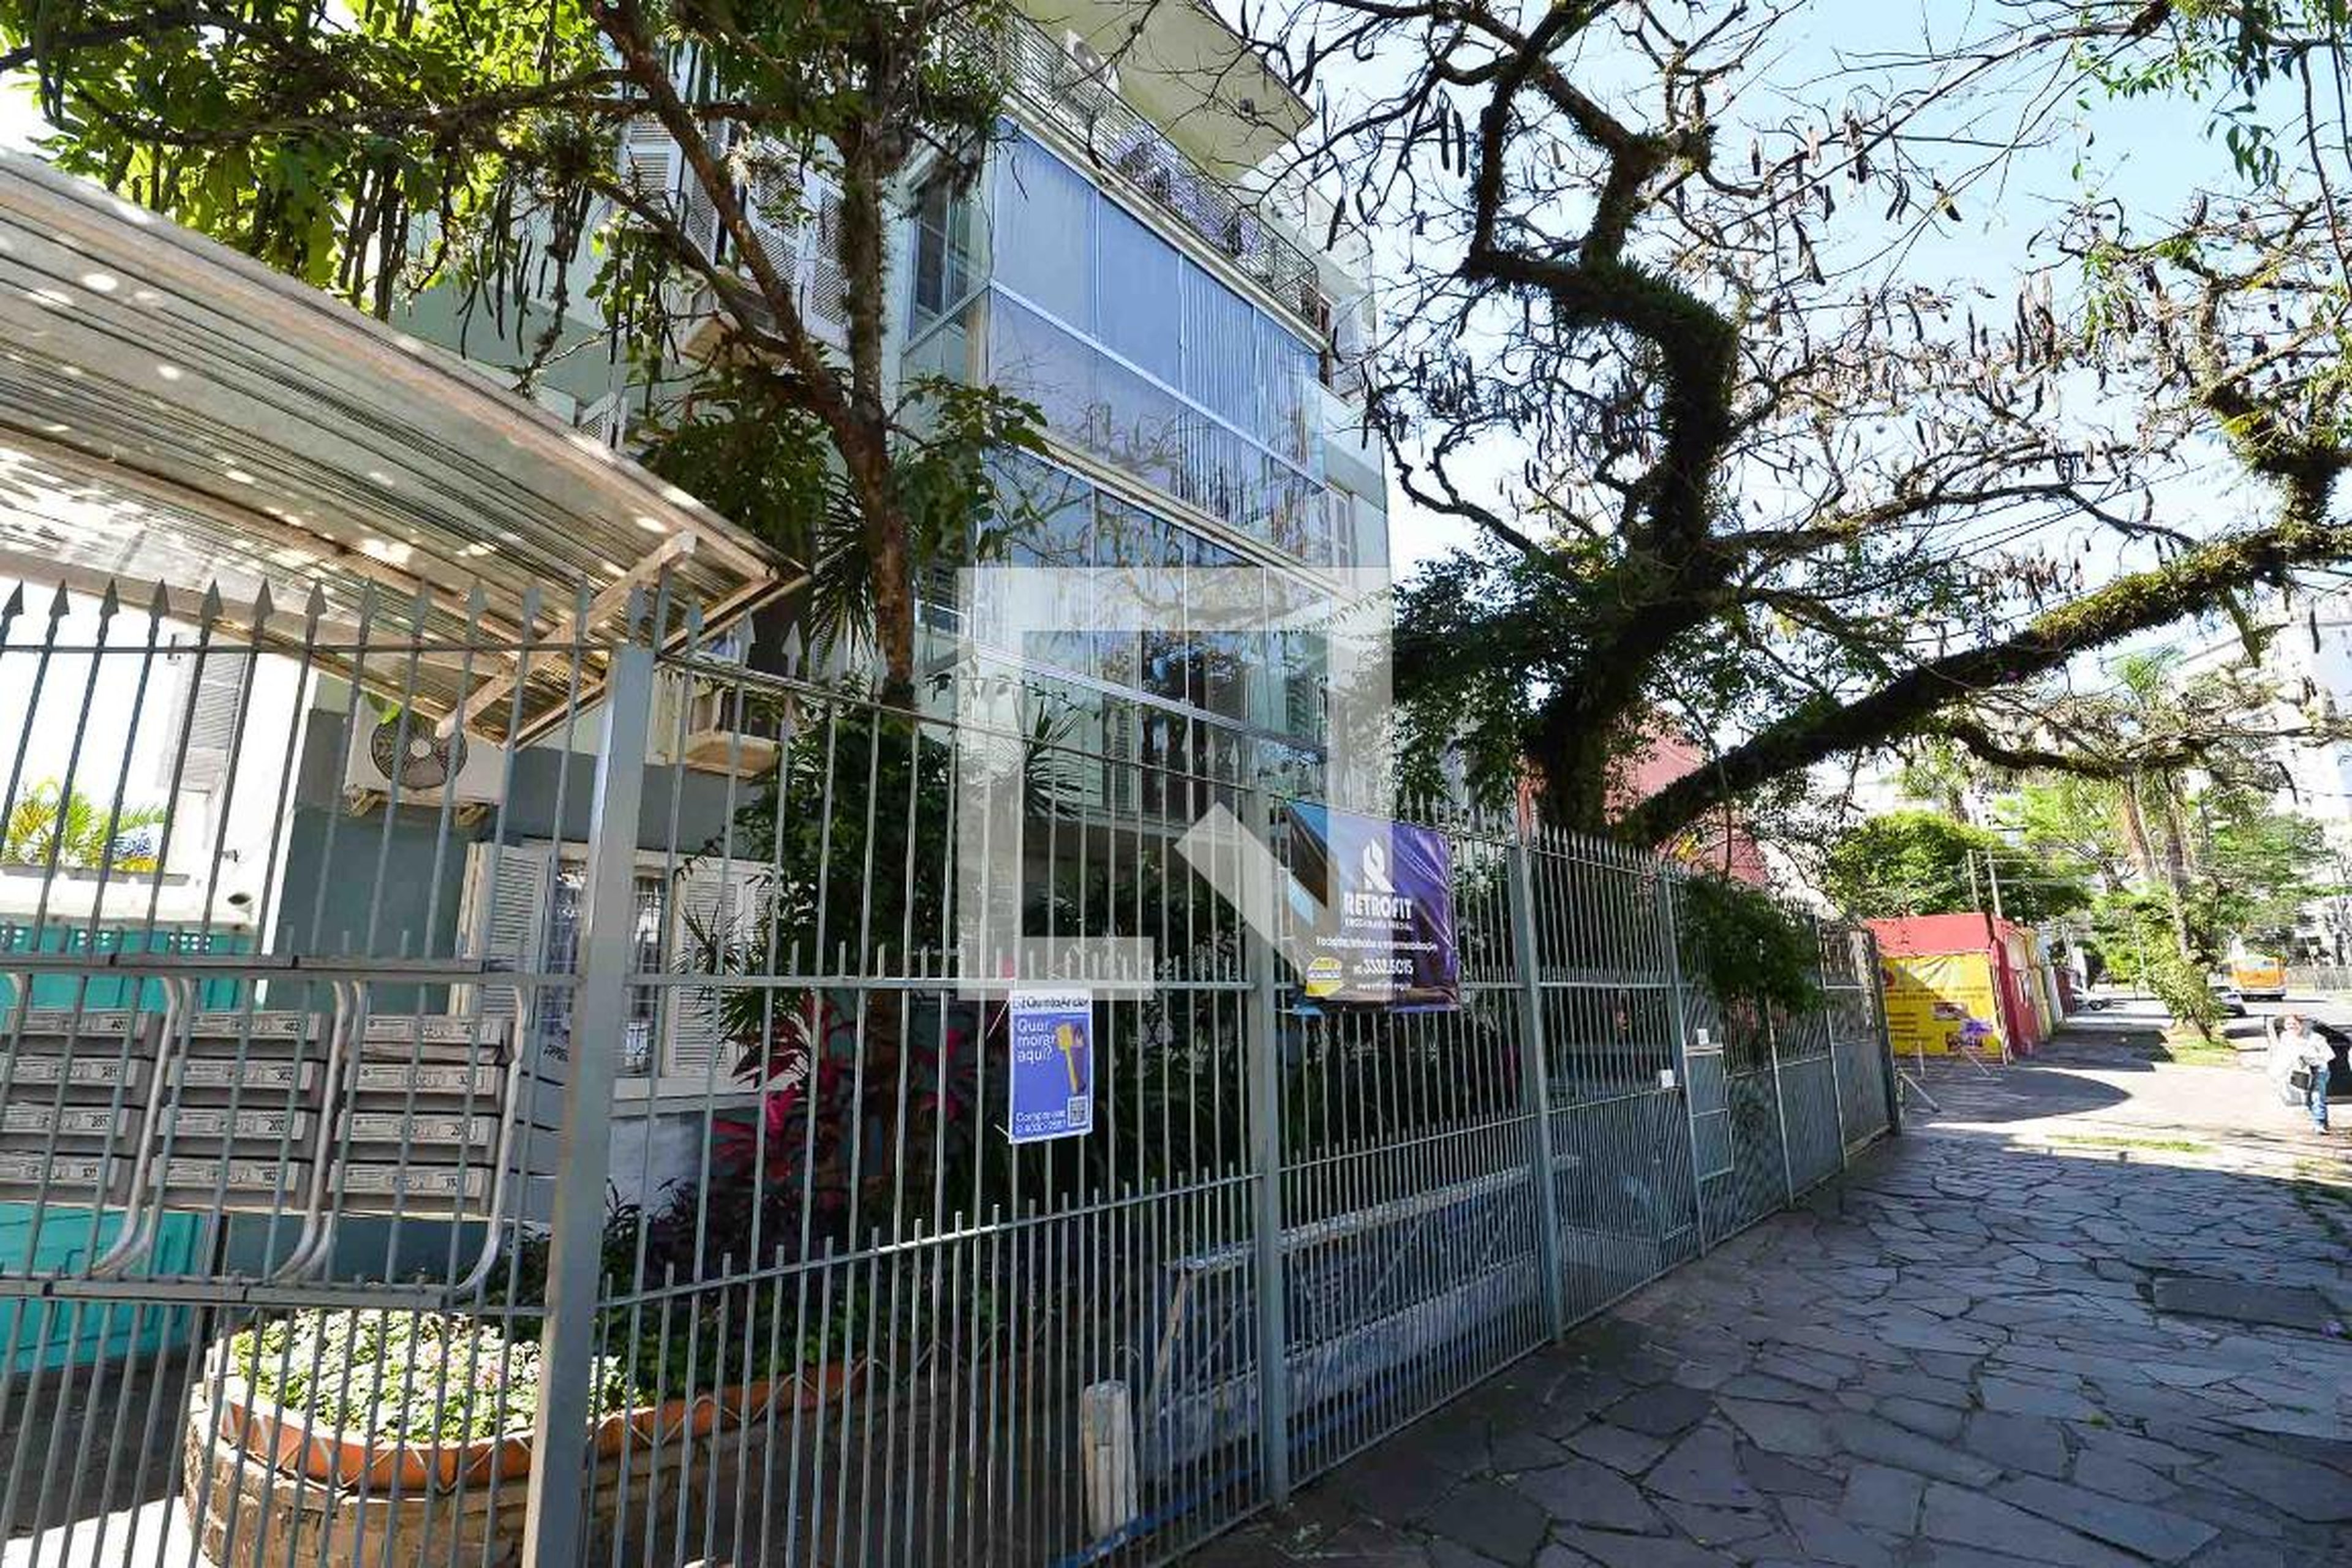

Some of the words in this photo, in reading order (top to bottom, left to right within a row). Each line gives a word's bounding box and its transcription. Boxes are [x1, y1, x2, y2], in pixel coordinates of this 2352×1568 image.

[1344, 891, 1412, 919] RETROFIT
[1017, 1033, 1057, 1047] morar
[1017, 1044, 1053, 1065] aqui?
